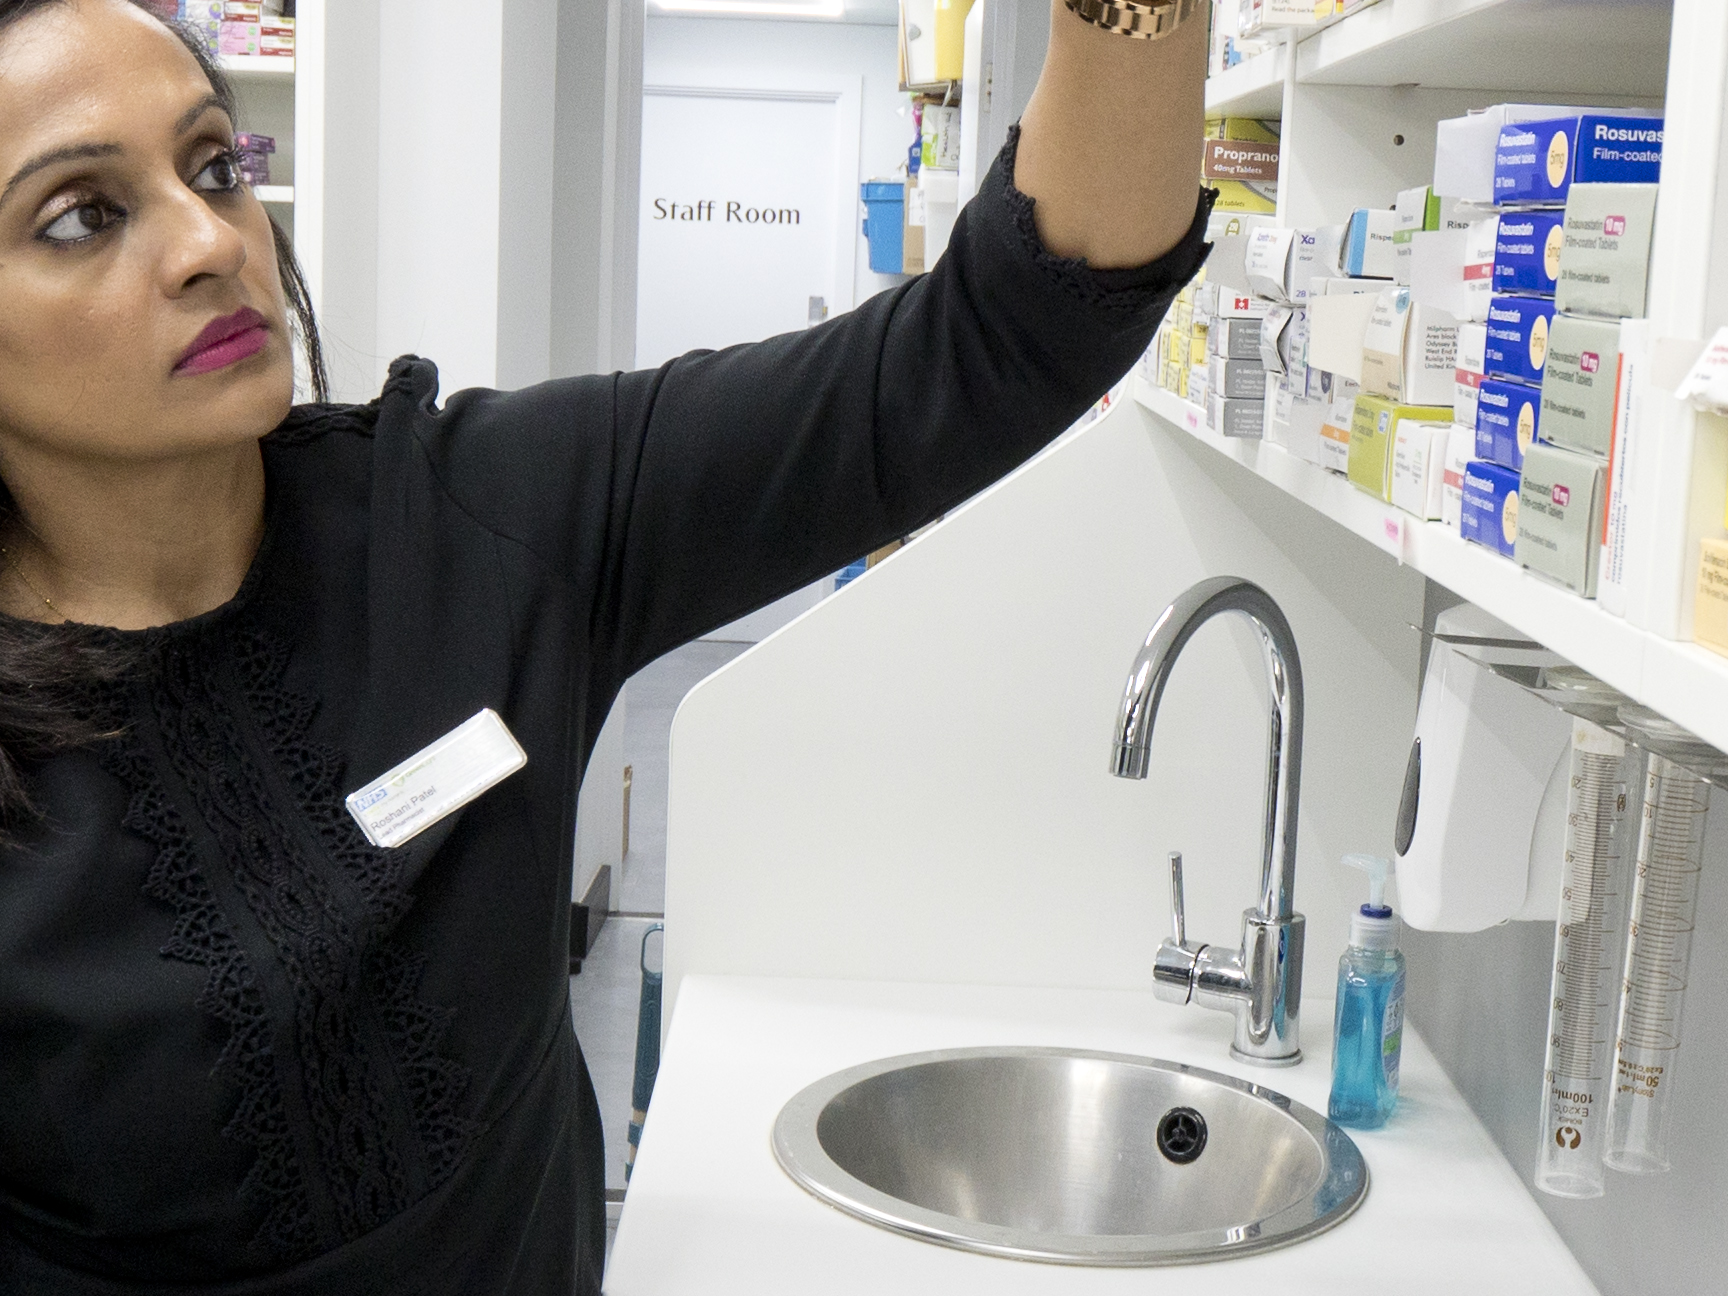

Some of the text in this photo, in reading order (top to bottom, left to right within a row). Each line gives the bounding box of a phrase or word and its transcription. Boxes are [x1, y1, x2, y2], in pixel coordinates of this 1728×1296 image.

[1213, 164, 1263, 174] 40mg Tablets
[1550, 149, 1565, 168] 5mg
[653, 198, 801, 225] Staff Room
[356, 787, 387, 811] NHS
[371, 785, 437, 832] Roshani Patel
